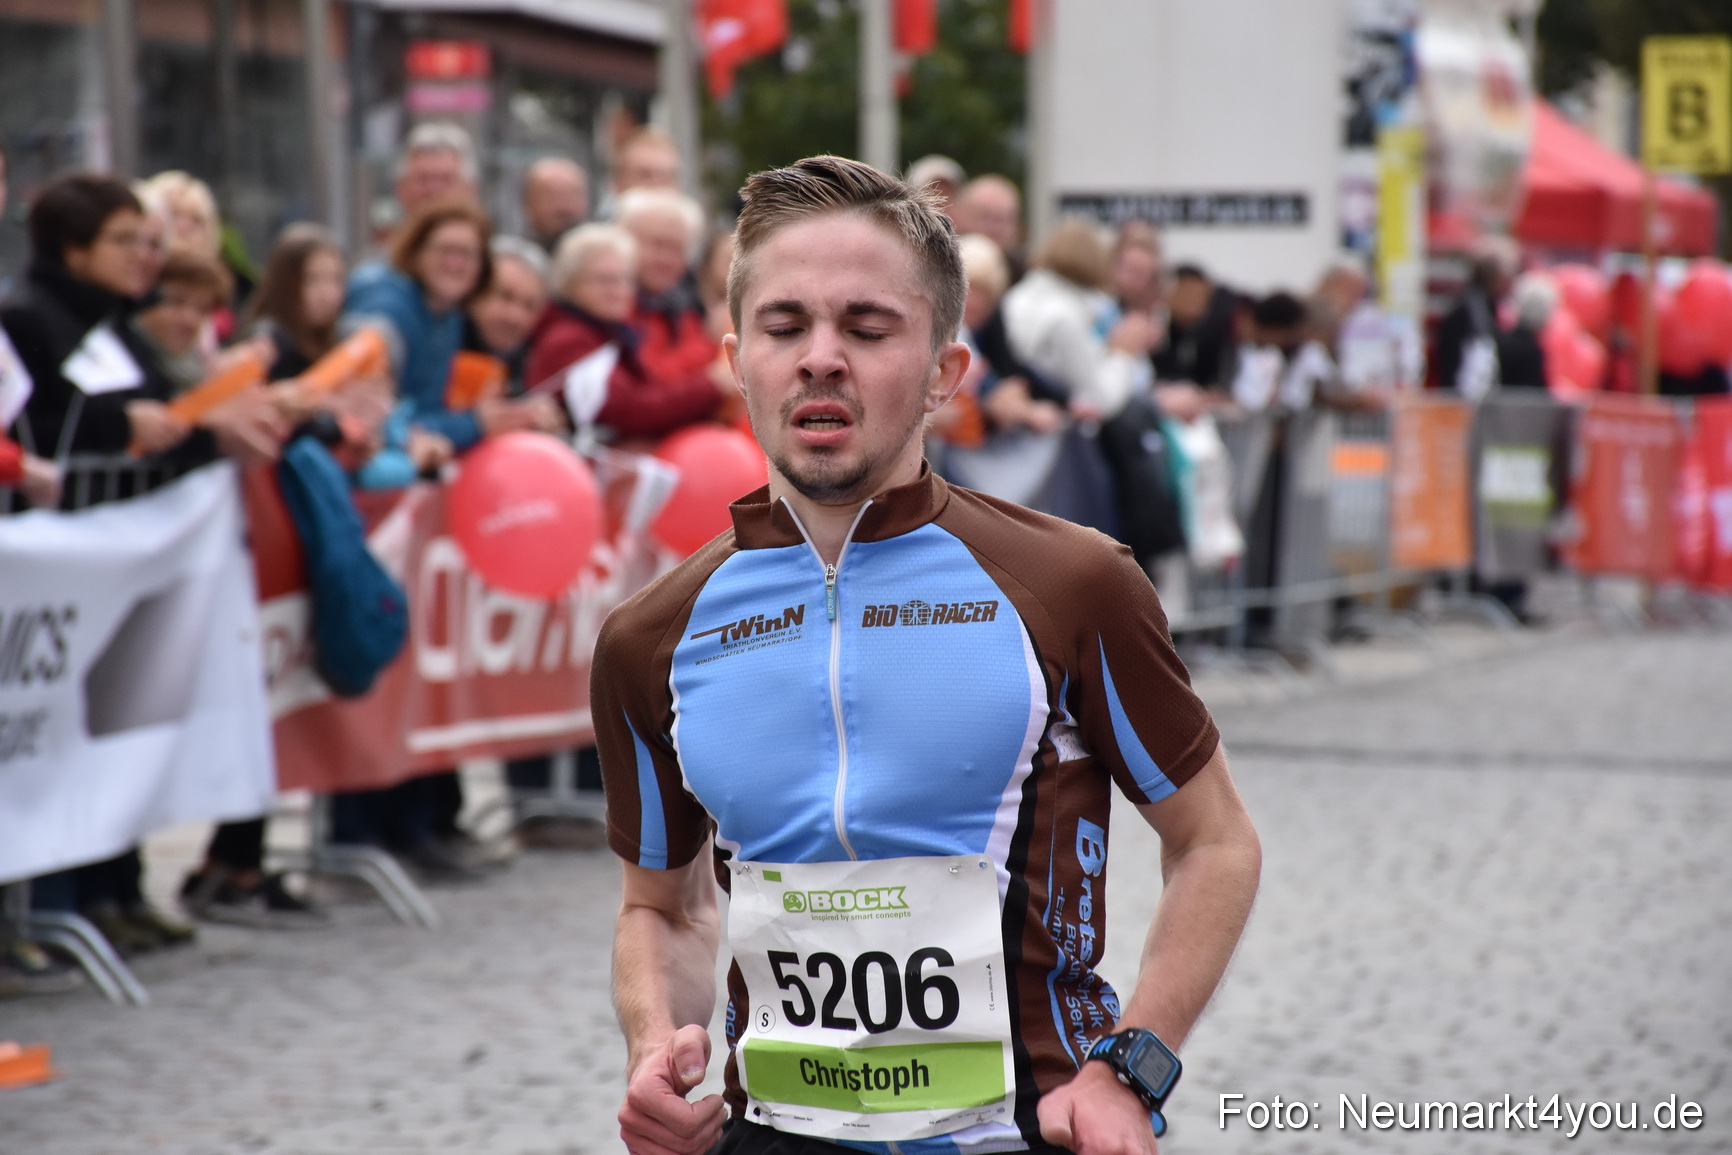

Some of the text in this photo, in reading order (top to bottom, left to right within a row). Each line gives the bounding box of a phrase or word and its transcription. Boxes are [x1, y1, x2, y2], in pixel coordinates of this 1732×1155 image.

[1668, 82, 1711, 141] B
[930, 600, 999, 626] RACER
[722, 631, 786, 651] TRIATHLONVEREIN
[695, 649, 745, 666] WINDSCHATTEN
[808, 886, 910, 912] BOCK
[811, 910, 912, 922] inspired by smart concepts
[767, 946, 960, 1034] 5206
[761, 1012, 769, 1028] S
[800, 1058, 930, 1096] Christoph
